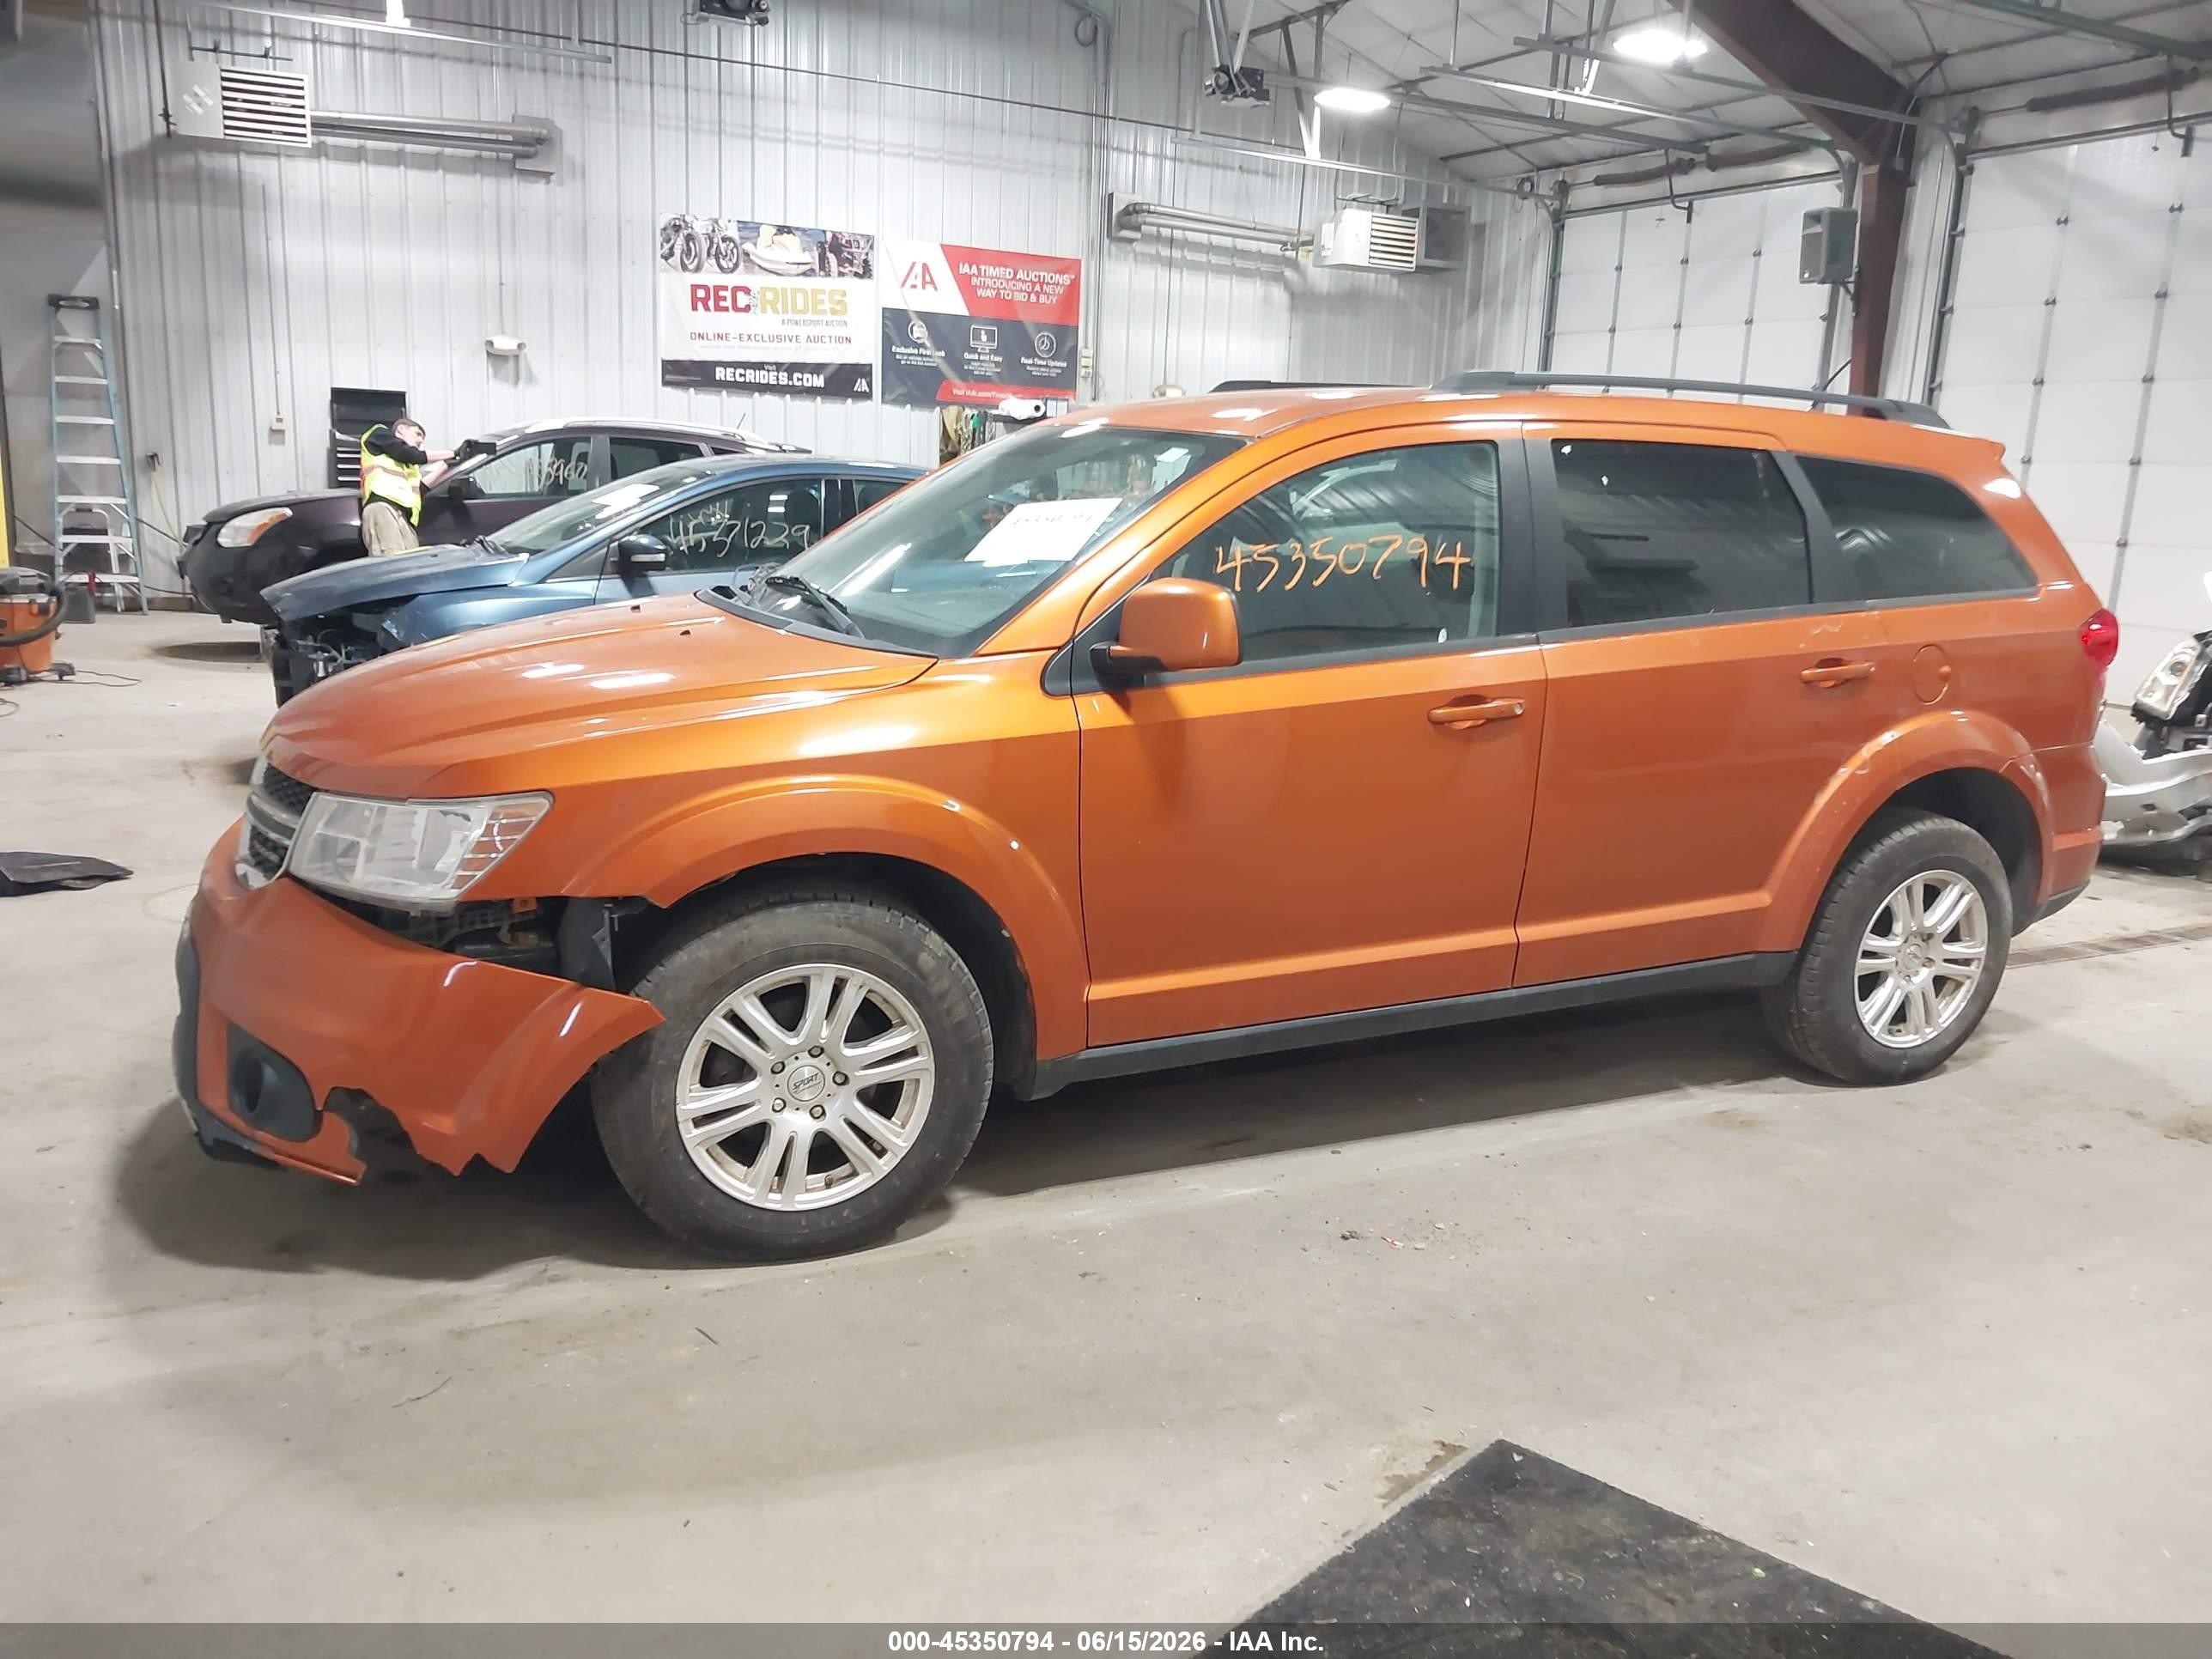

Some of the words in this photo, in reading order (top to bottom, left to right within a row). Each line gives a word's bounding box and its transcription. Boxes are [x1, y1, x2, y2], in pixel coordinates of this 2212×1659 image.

[959, 262, 979, 276] IAA
[979, 264, 1013, 279] TIMED
[971, 276, 1031, 292] INTRODUCING
[1035, 284, 1042, 293] A
[1042, 284, 1065, 295] NEW
[690, 283, 751, 313] REC
[760, 287, 848, 316] RIDES
[976, 288, 998, 299] WAY
[1000, 289, 1012, 300] TO
[1014, 291, 1029, 301] BID
[1030, 293, 1037, 302] &
[1038, 293, 1058, 304] BUY
[787, 319, 823, 328] POWERSPORT
[824, 319, 848, 328] AUCTION
[690, 331, 801, 343] ONLINE-EXCLUSIVE
[805, 334, 852, 345] AUCTION
[714, 366, 825, 388] RECRIDES.COM
[1215, 534, 1473, 592] 45350794
